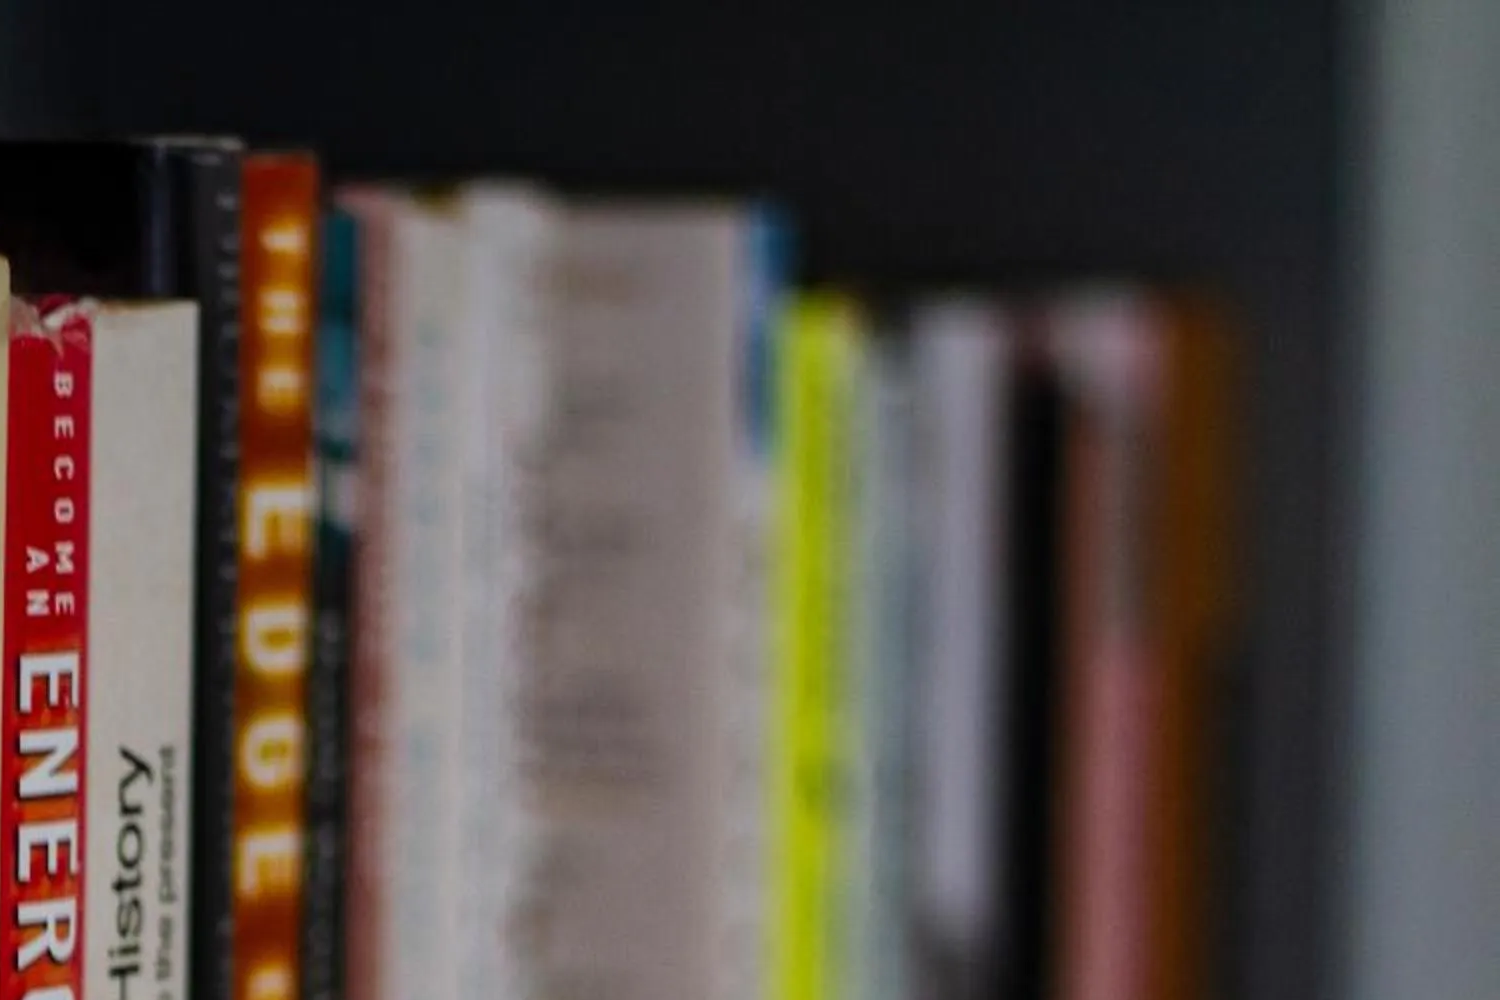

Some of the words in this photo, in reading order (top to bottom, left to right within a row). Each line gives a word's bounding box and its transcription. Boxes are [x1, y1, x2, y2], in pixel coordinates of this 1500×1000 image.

[53, 370, 75, 616] BECOME
[25, 546, 50, 617] AN
[242, 483, 315, 894] EDGE
[158, 745, 177, 905] present
[156, 914, 174, 982] the
